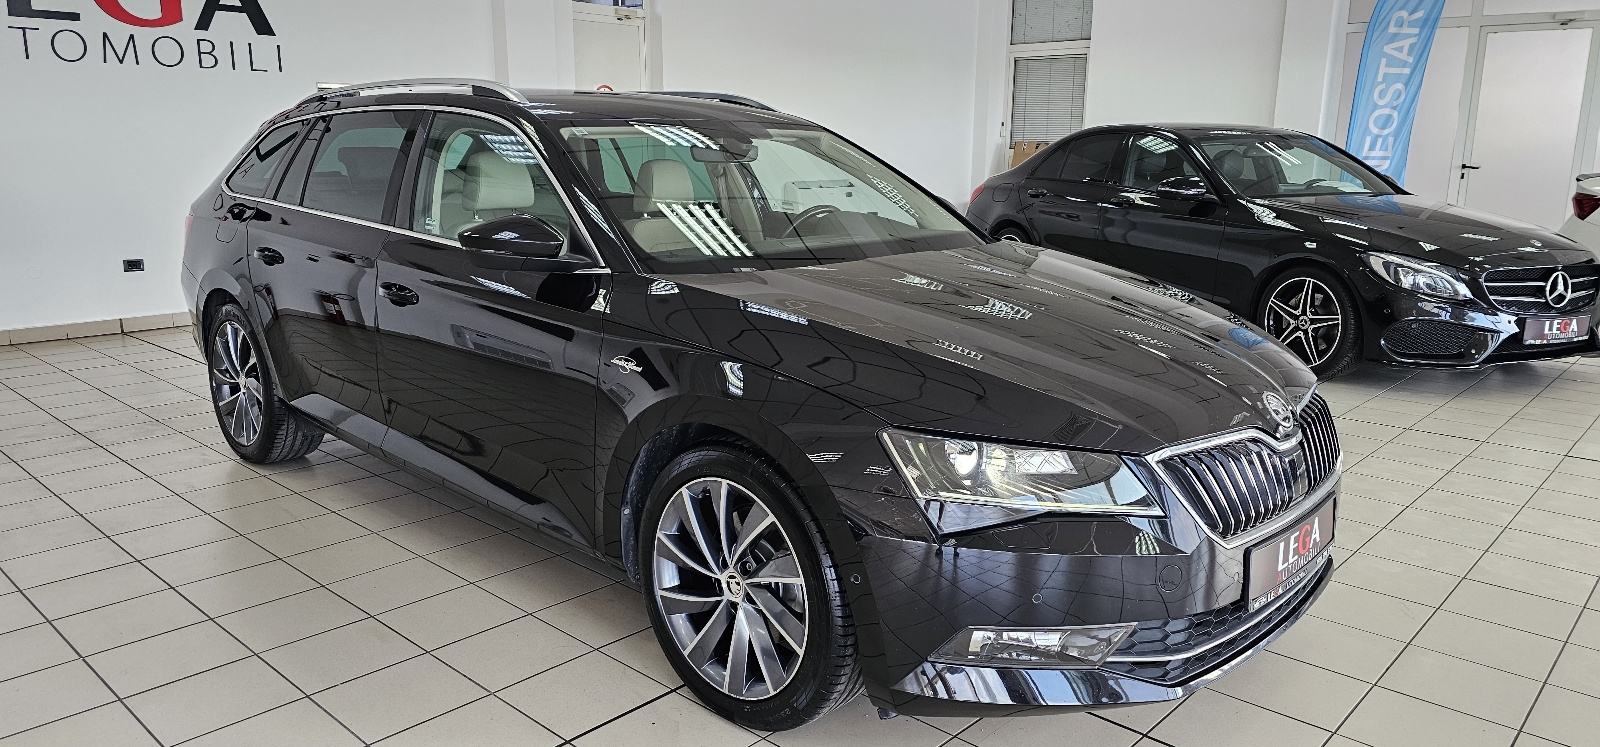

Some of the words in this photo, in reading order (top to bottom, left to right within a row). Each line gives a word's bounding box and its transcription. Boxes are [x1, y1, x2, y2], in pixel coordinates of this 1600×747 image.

[7, 25, 283, 73] TOMOBILI
[1544, 318, 1578, 334] LEGA
[1278, 516, 1320, 571] LEGA
